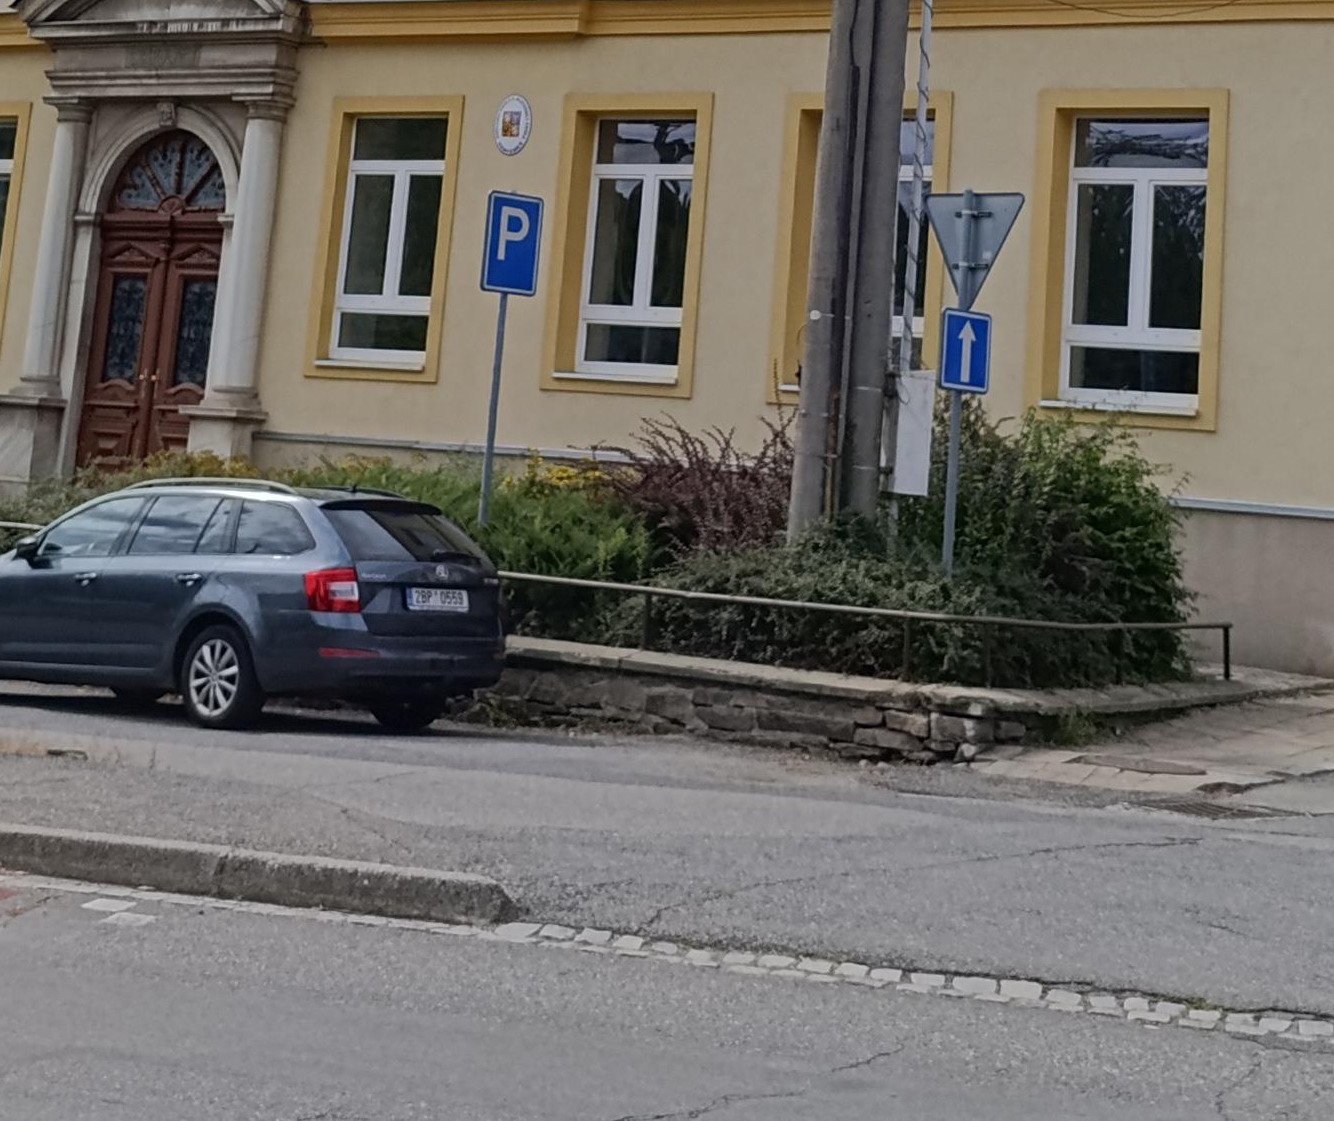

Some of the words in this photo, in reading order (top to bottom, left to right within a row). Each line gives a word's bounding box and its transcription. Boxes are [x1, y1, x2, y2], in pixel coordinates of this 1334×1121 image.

[497, 205, 530, 261] P
[415, 589, 432, 605] 2BP
[440, 590, 464, 606] 0559
